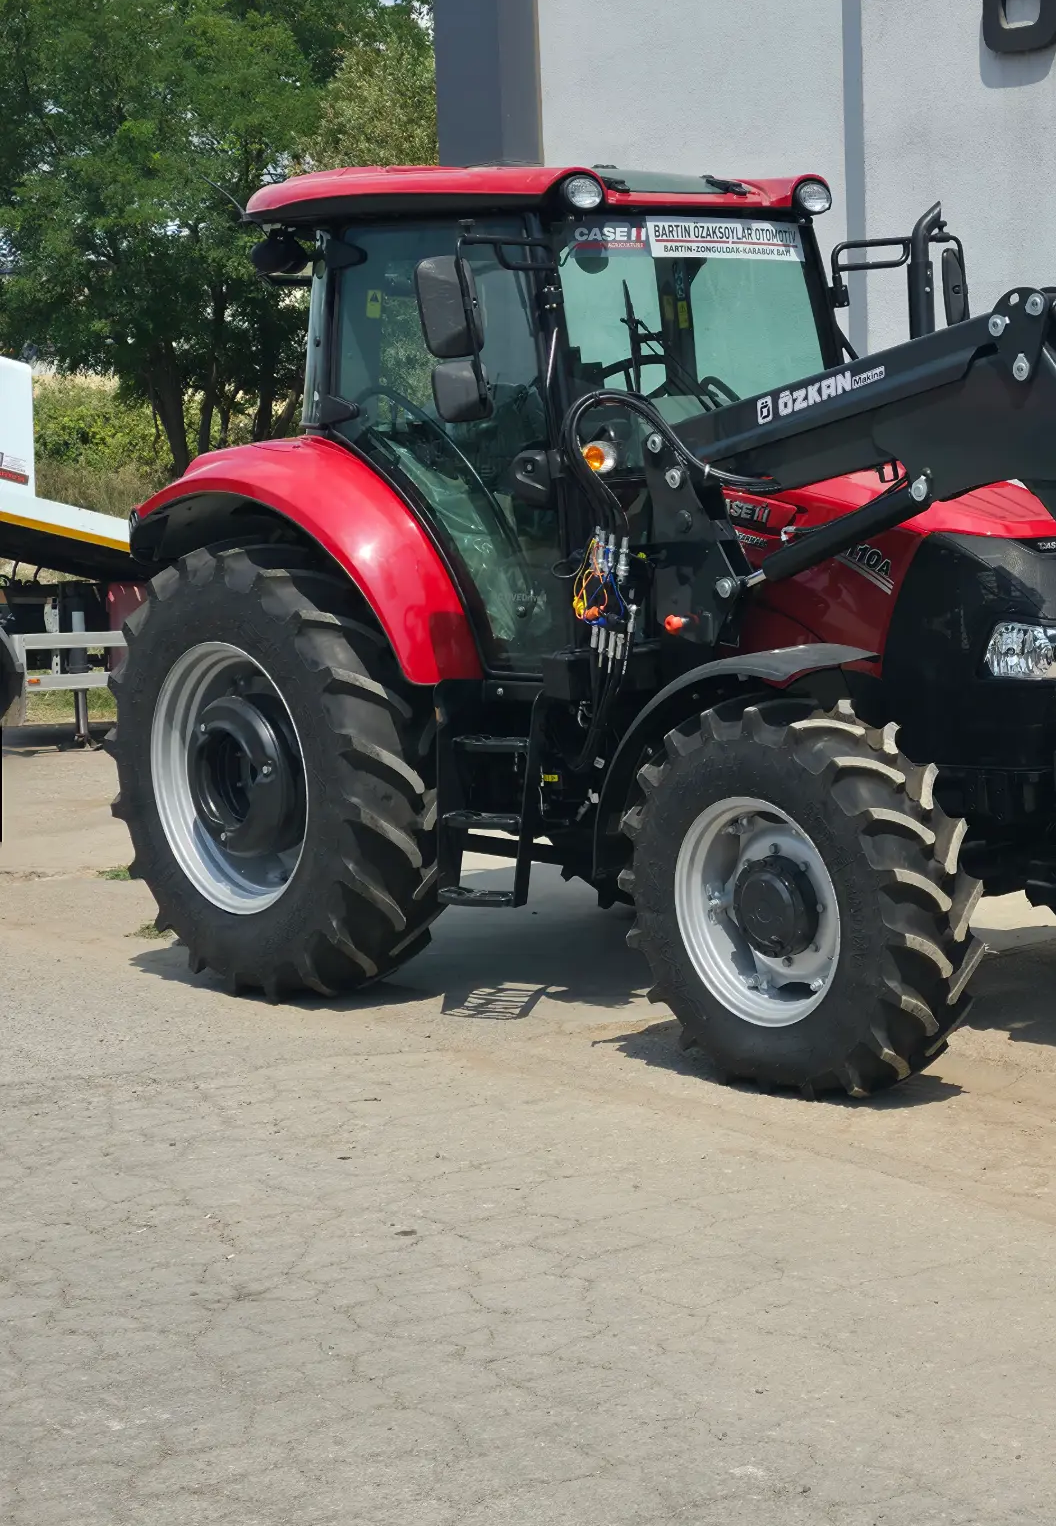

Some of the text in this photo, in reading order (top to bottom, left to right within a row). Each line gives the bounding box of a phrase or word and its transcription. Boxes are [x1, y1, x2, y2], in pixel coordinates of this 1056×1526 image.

[574, 227, 628, 241] CASE
[653, 221, 796, 244] BARTIN ÖZAKSOYLAR OTOMOTİV
[778, 371, 852, 416] ÖZKAN
